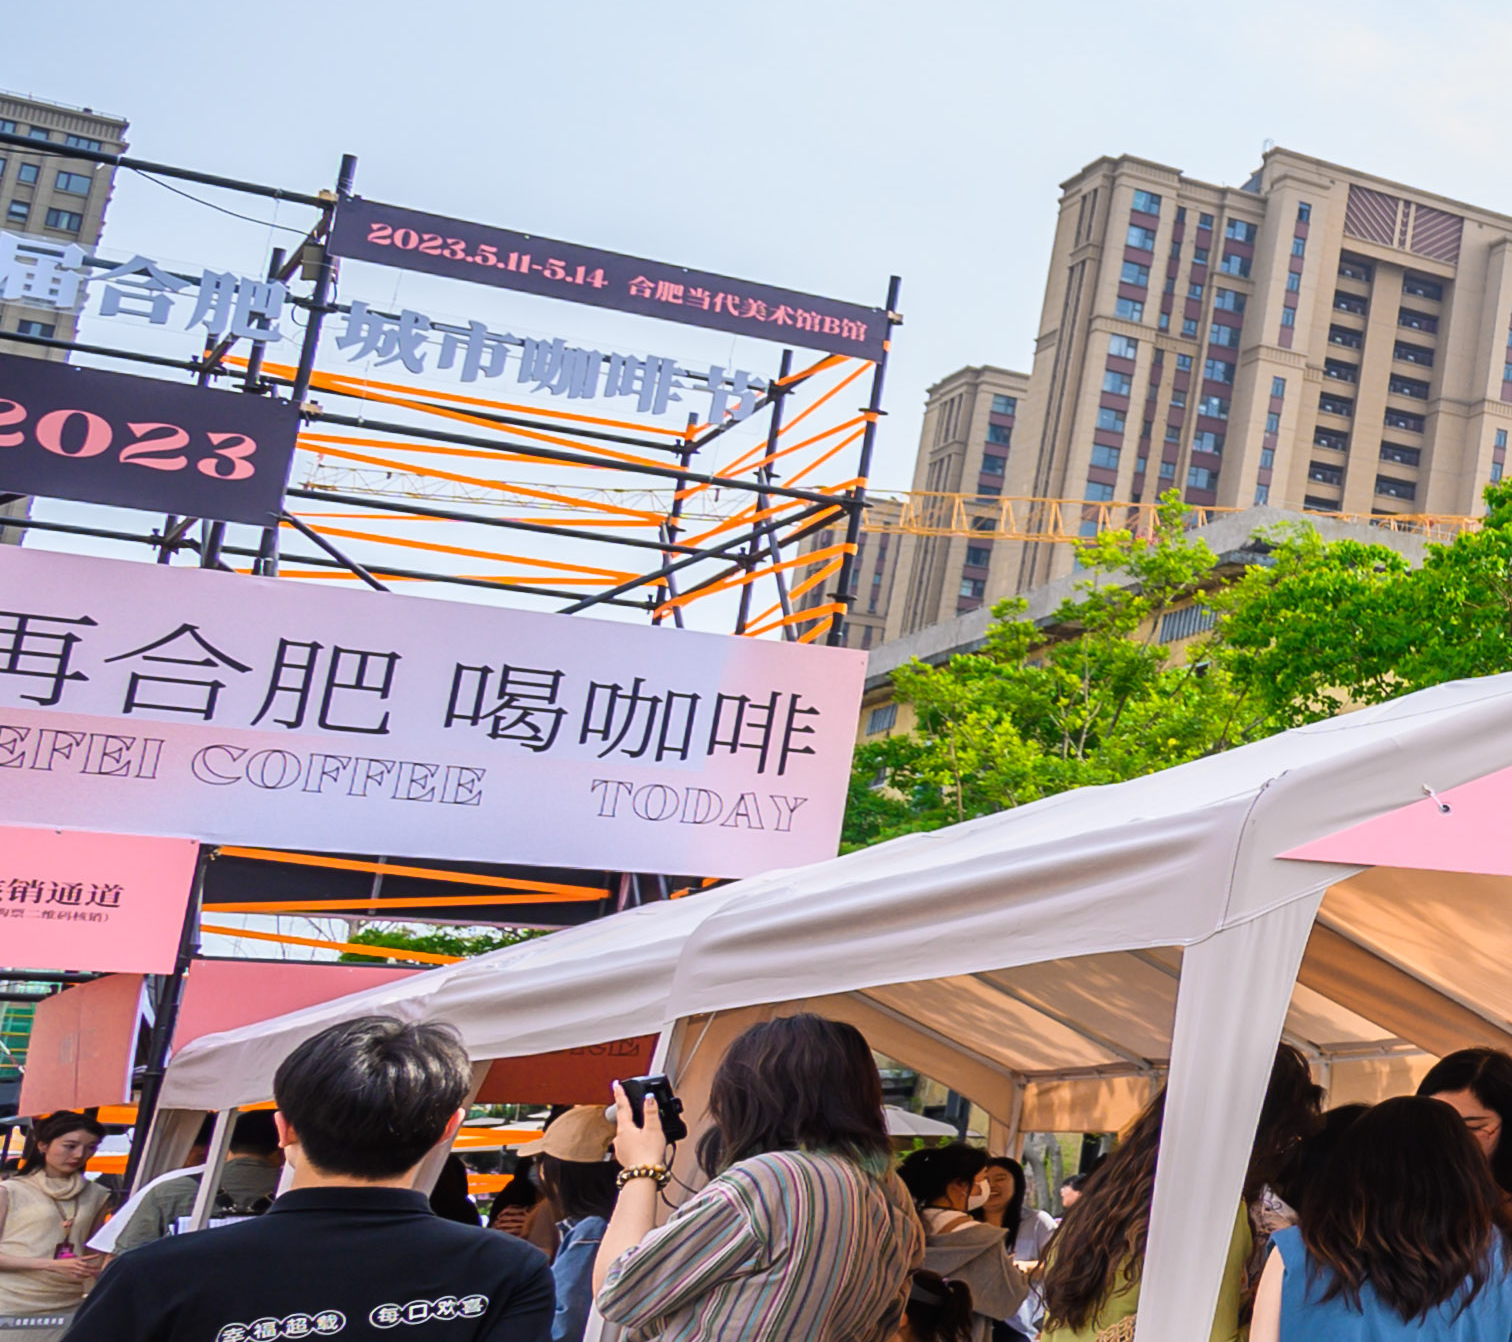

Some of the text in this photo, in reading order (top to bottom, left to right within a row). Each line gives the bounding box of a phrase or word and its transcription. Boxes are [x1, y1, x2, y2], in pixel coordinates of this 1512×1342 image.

[366, 222, 868, 343] 2023.5.11-5.14 合肥当代美术馆B馆
[335, 299, 770, 425] 城市咖啡节
[0, 610, 821, 777] 再合肥 喝咖啡
[190, 743, 487, 807] COFFEE
[590, 778, 809, 833] TODAY
[0, 878, 125, 909] 销通道
[377, 1295, 485, 1325] 每口欢喜
